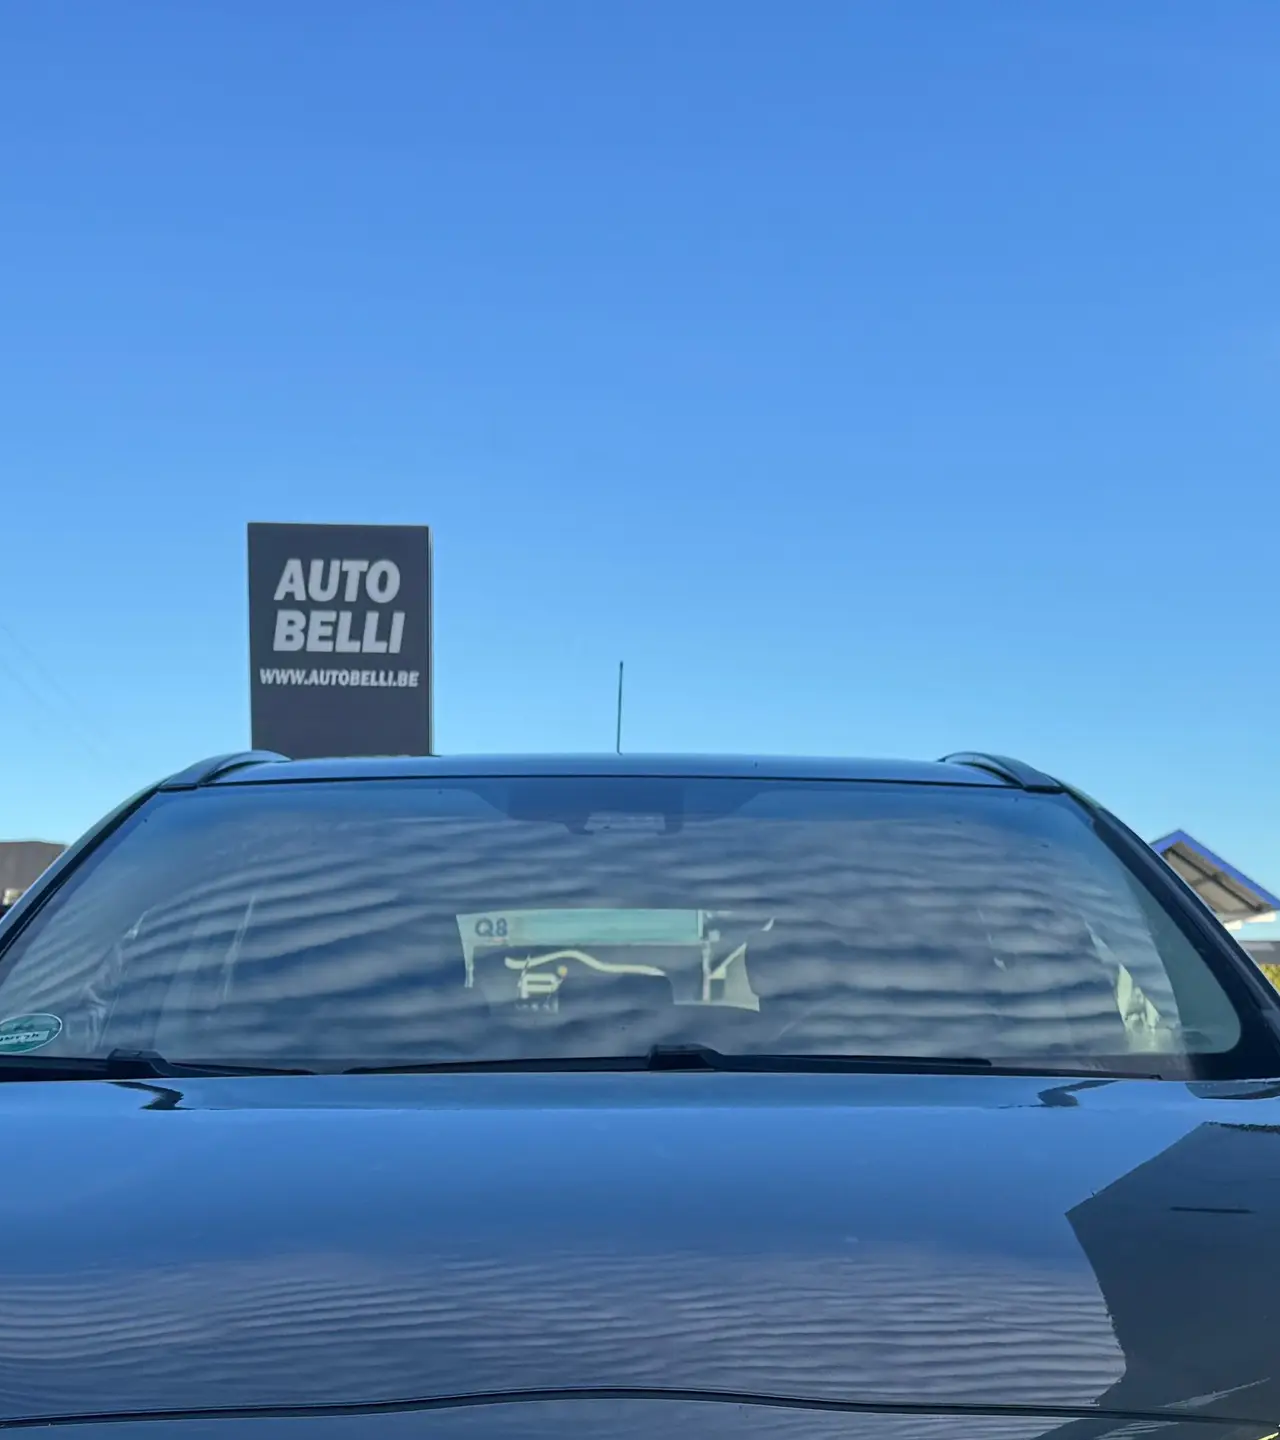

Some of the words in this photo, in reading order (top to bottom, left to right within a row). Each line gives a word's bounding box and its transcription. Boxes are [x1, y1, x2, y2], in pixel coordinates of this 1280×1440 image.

[273, 558, 401, 604] AUTO
[272, 609, 406, 653] BELLI
[259, 668, 420, 687] WWW.AUTOBELLI.BE
[474, 917, 508, 937] Q8
